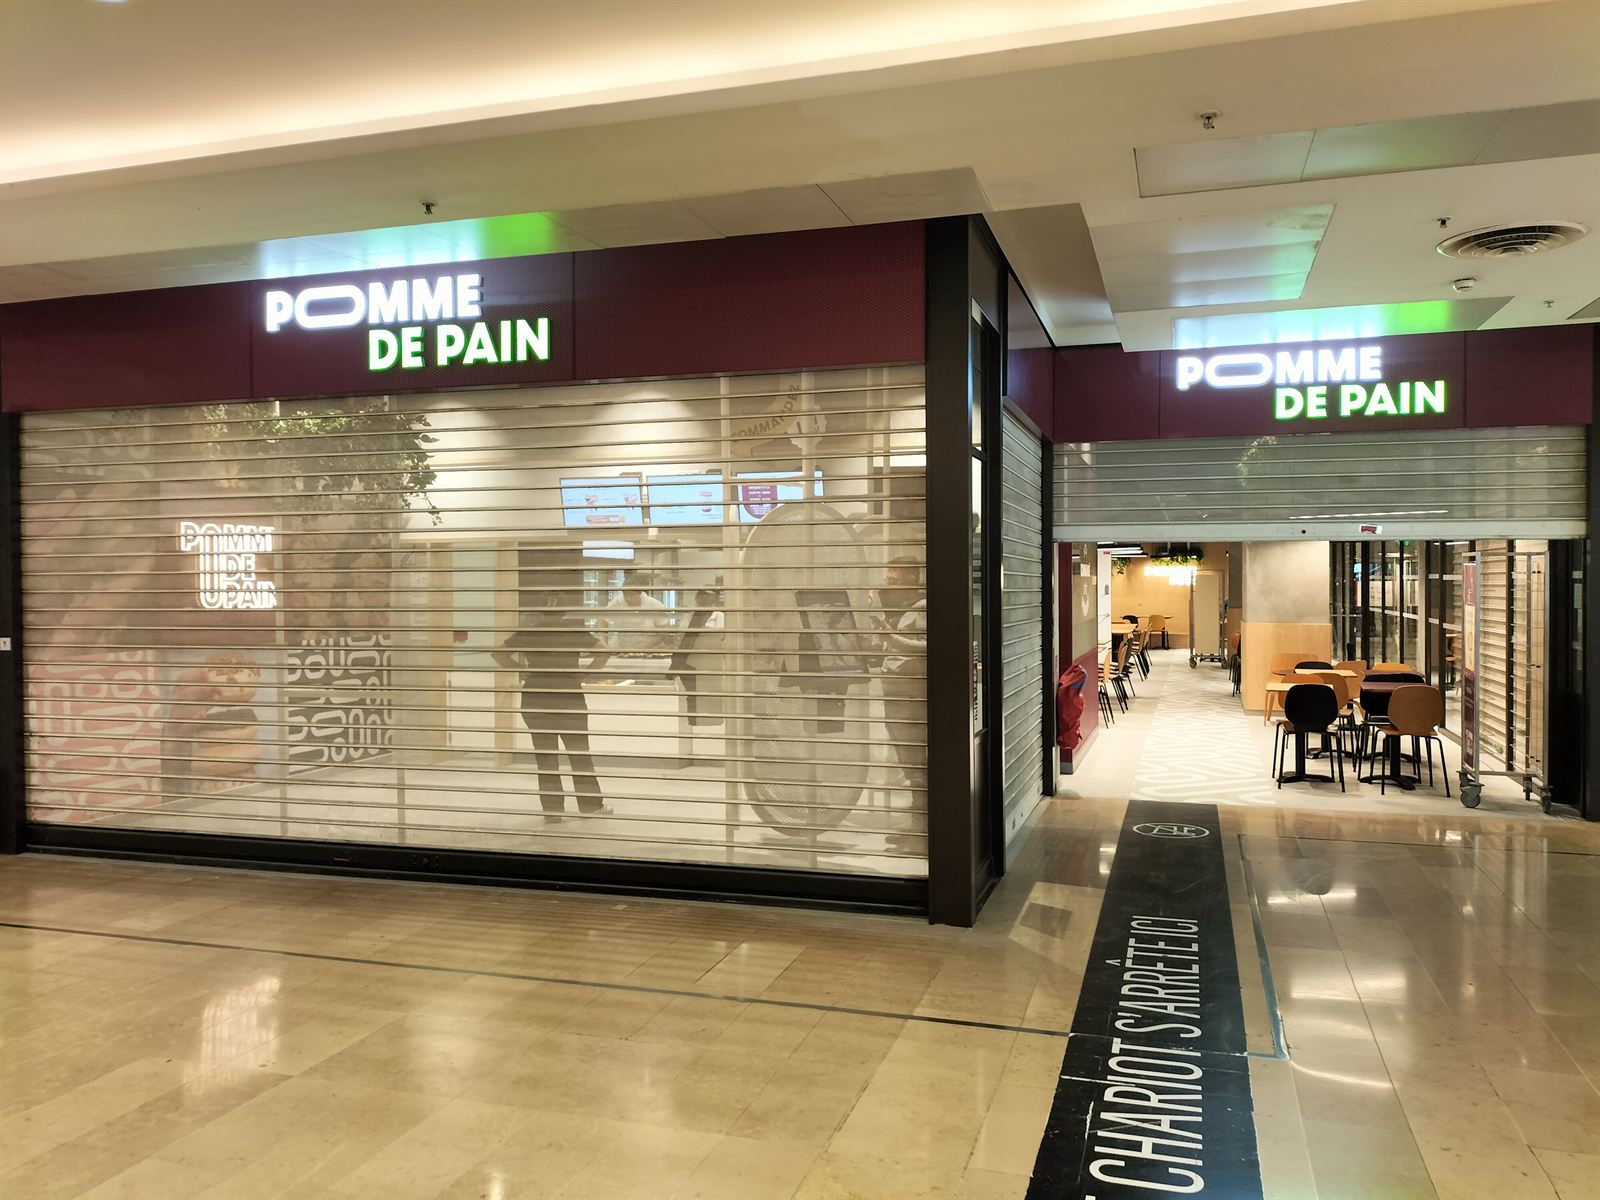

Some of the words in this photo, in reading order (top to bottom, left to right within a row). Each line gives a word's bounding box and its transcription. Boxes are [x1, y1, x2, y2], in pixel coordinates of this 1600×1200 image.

[265, 273, 481, 333] POMME
[368, 326, 425, 370] DE
[436, 317, 549, 366] PAIN
[1176, 346, 1383, 391] POMME
[1275, 385, 1328, 419] DE
[1339, 380, 1446, 417] PAIN
[1130, 915, 1199, 938] ICI
[1105, 937, 1202, 1038] S'ARRÊTE
[1088, 1037, 1205, 1194] CHARIOT
